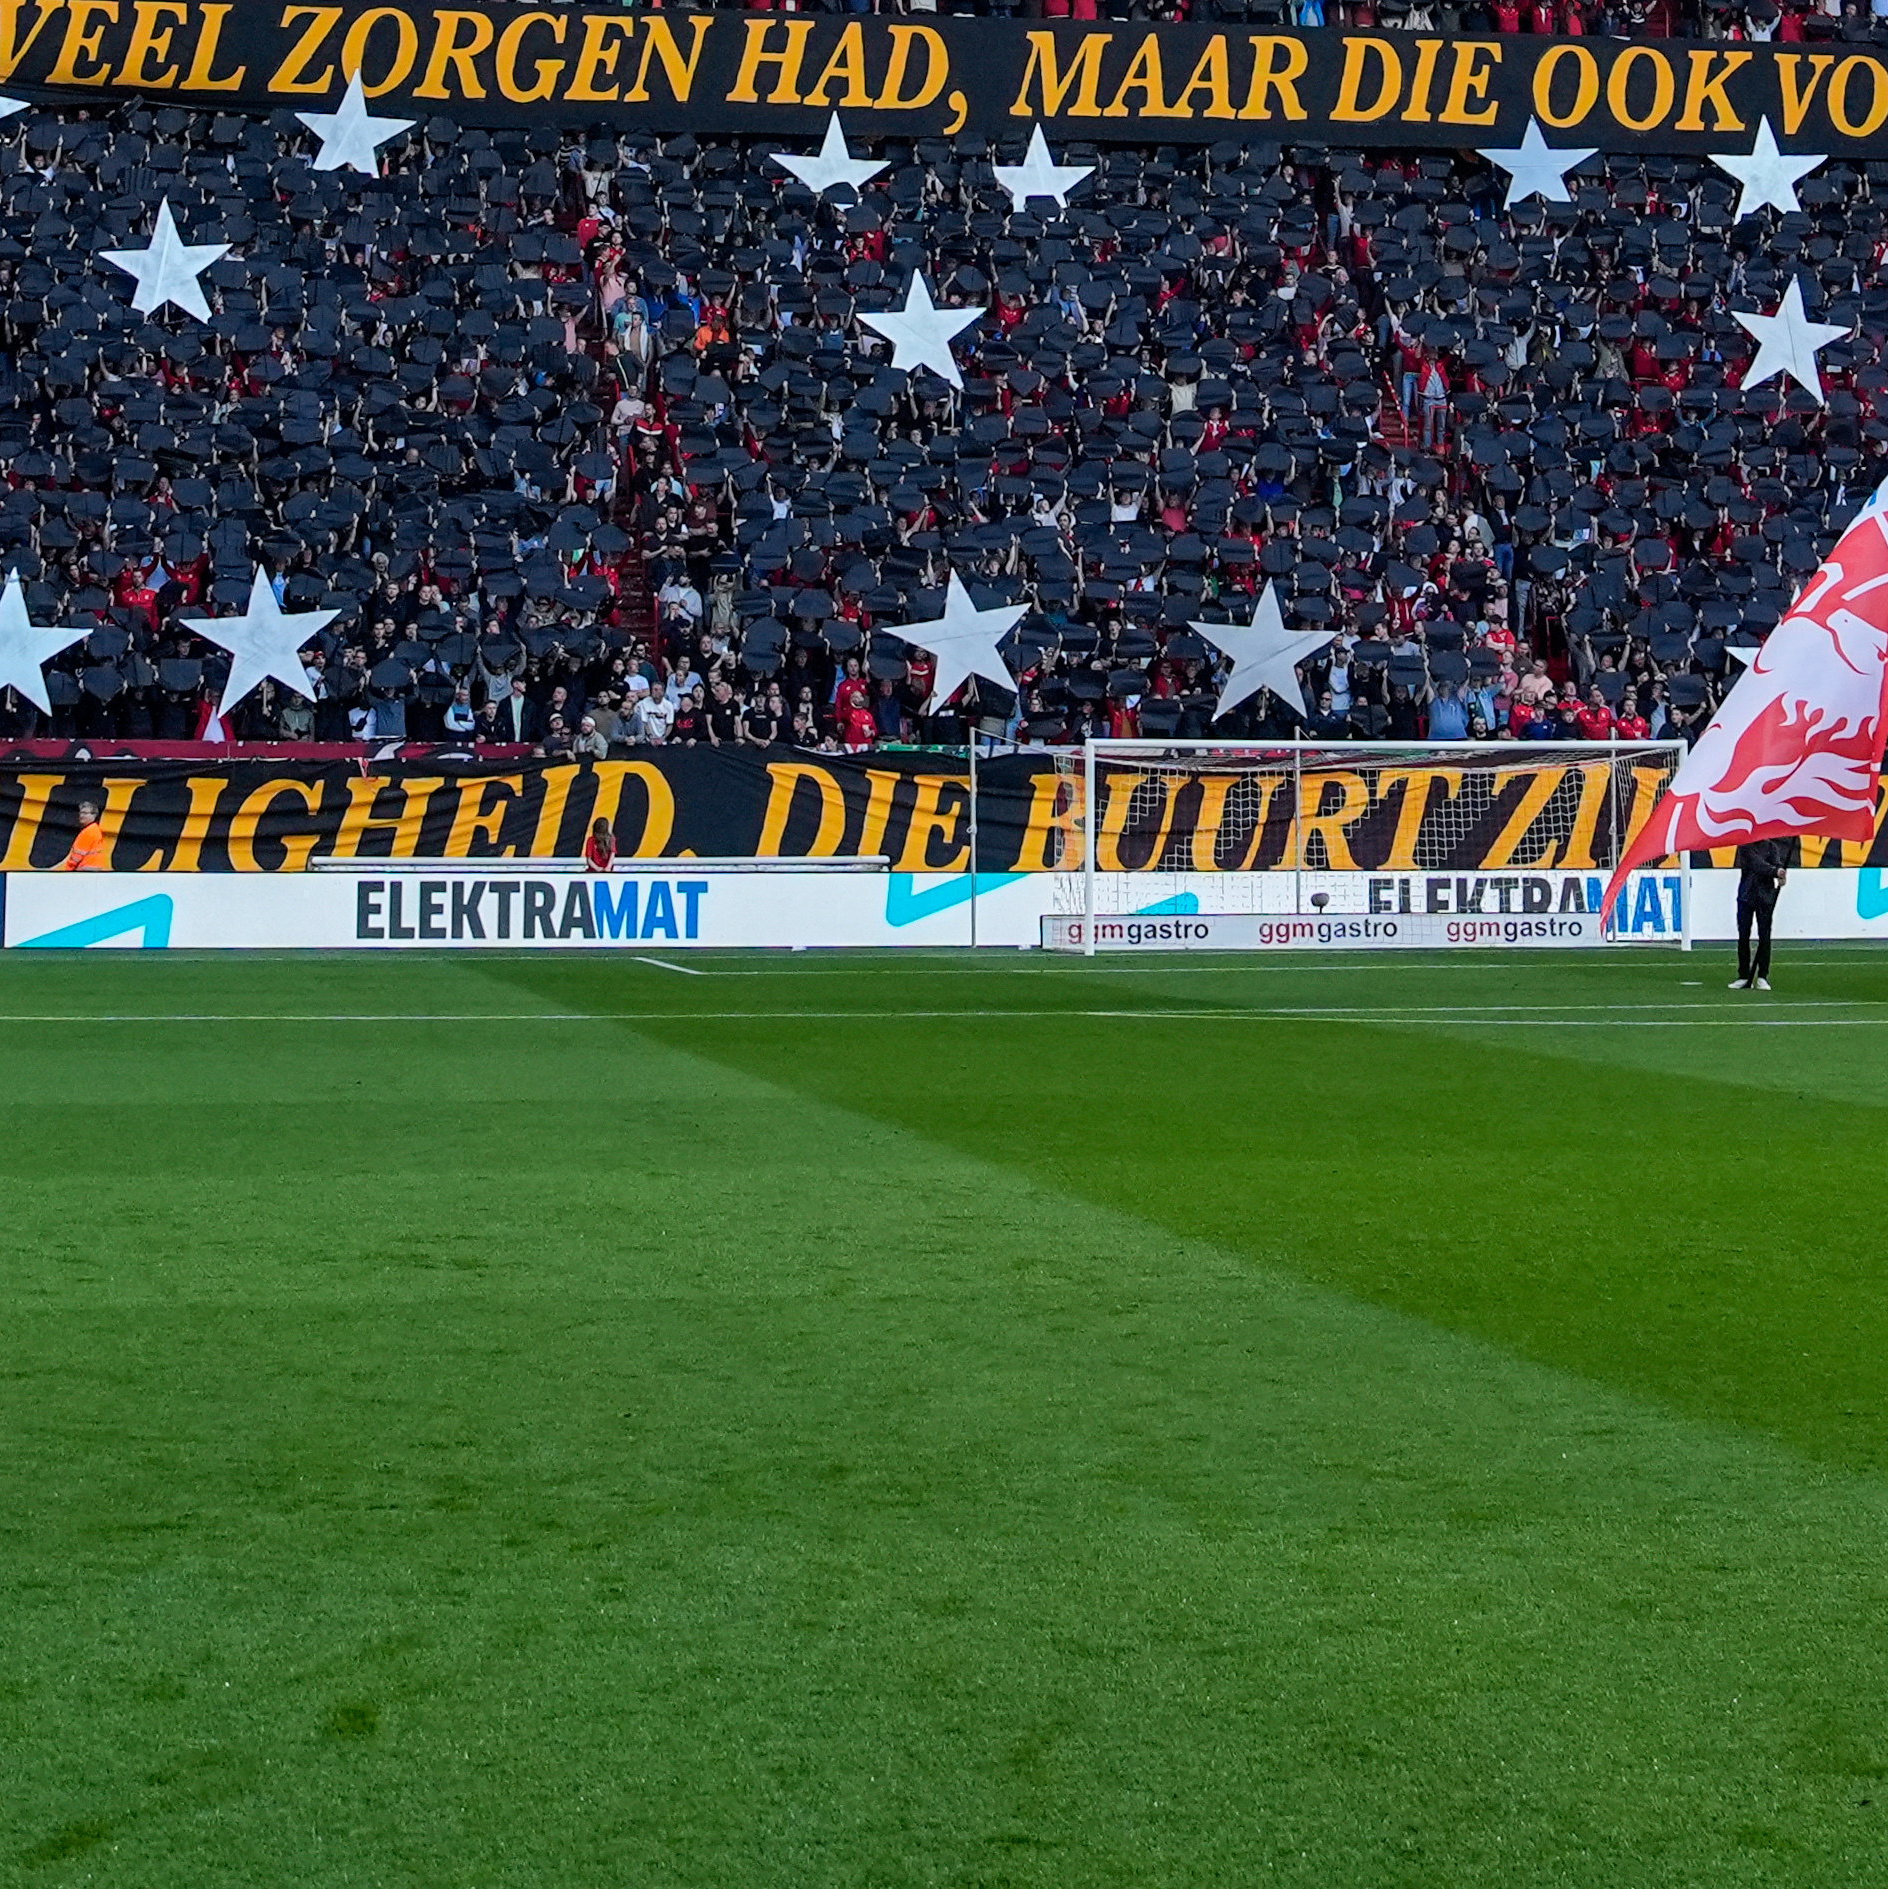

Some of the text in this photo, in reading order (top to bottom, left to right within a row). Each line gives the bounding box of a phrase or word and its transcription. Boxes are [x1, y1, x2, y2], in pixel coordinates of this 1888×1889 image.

[267, 6, 713, 105] ZORGEN
[726, 17, 968, 136] HAD,
[1009, 30, 1309, 122] MAAR
[1329, 37, 1503, 126] DIE
[1533, 44, 1754, 134] OOK
[755, 762, 978, 872] DIE
[1010, 767, 1461, 872] BUURT
[356, 880, 709, 940] ELEKTRAMAT
